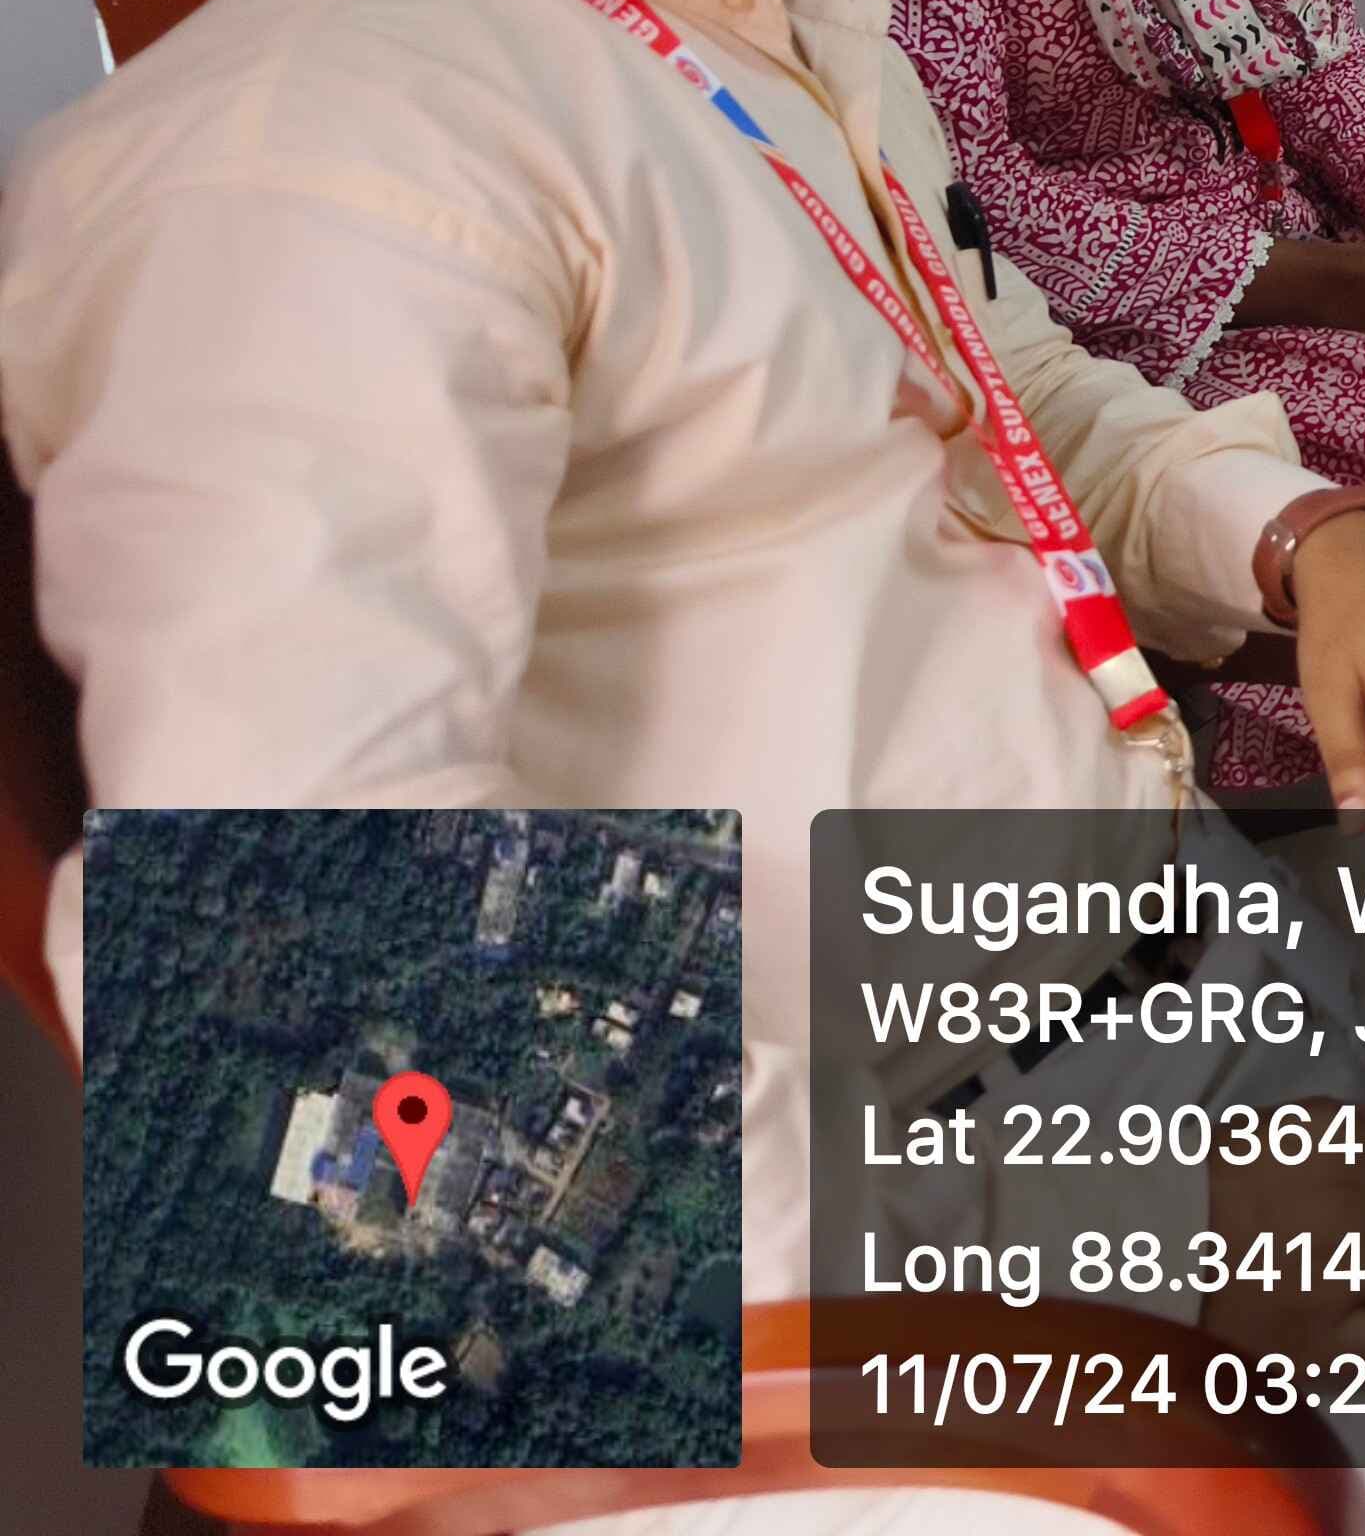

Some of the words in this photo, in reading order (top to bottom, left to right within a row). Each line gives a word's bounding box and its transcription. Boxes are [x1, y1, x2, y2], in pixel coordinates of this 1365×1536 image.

[889, 187, 948, 277] GROUP
[938, 285, 1031, 445] SUPTENNDU
[1014, 450, 1079, 540] GENEX
